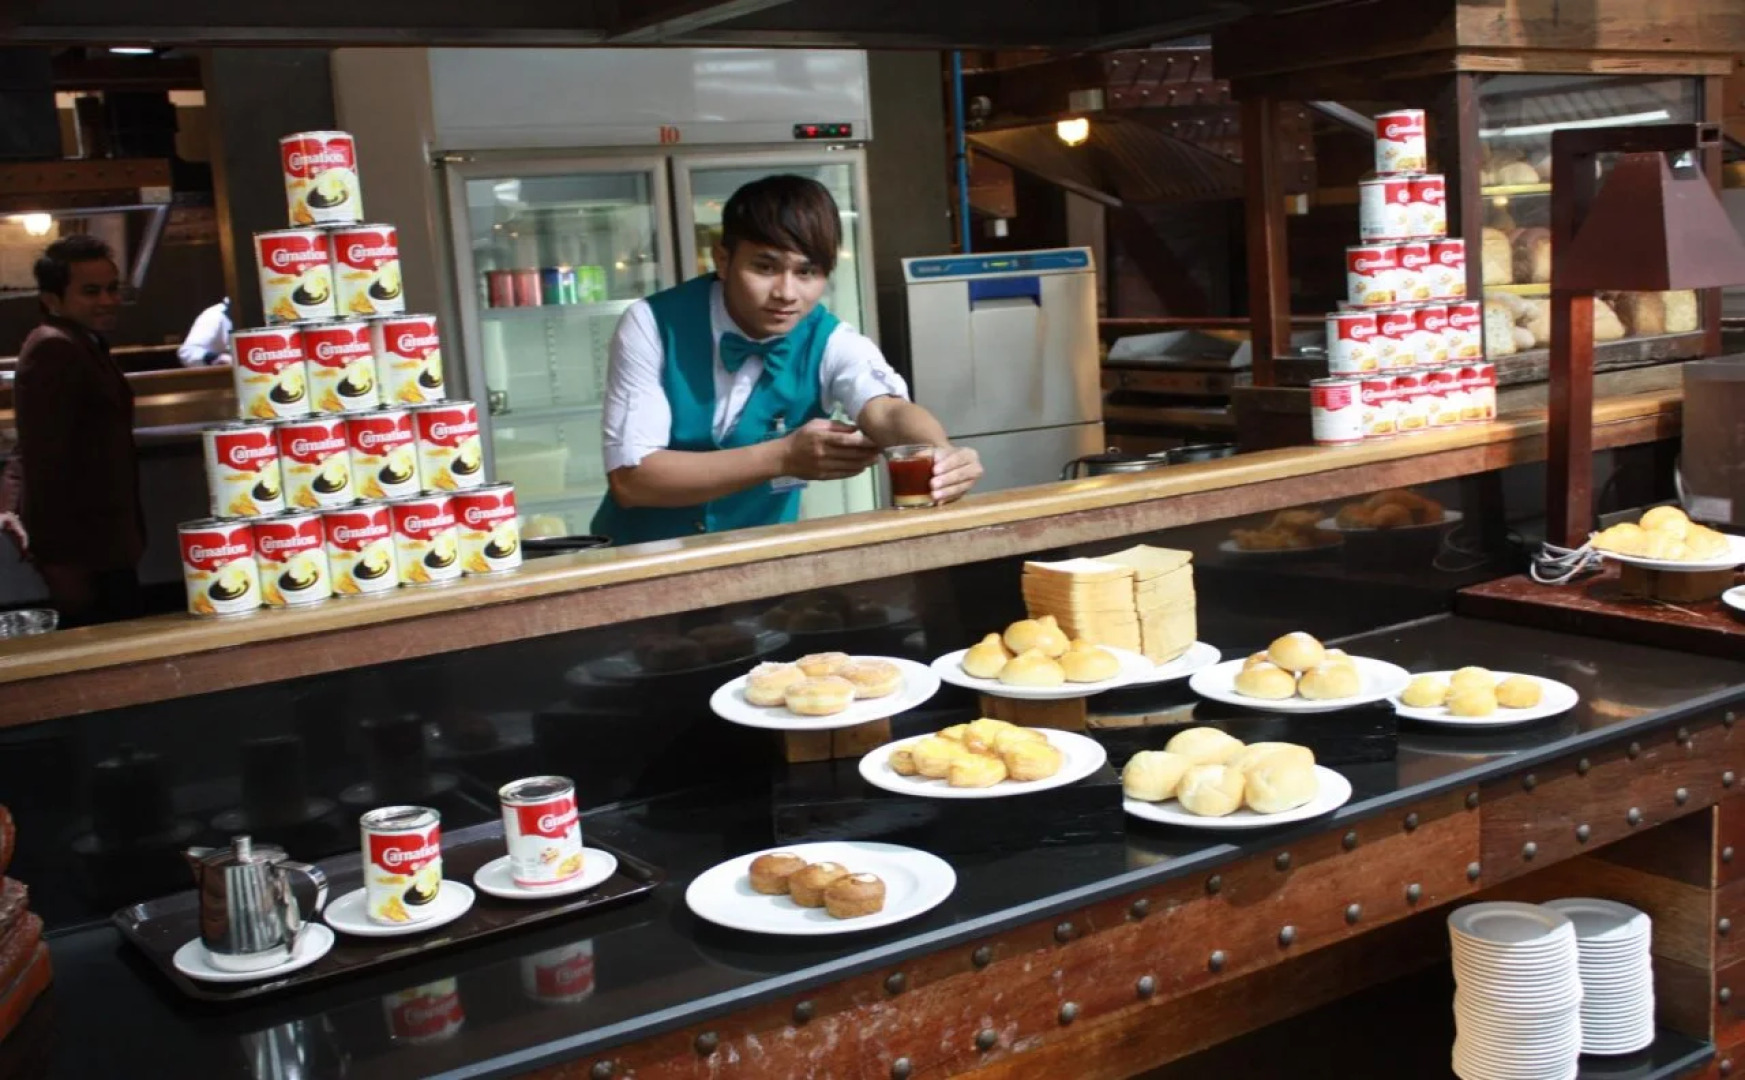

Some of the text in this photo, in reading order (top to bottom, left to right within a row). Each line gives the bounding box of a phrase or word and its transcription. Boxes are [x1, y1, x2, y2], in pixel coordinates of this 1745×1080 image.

[289, 152, 345, 170] Carnation
[272, 248, 328, 267] Carnation
[316, 341, 371, 360] Carnation
[291, 438, 346, 456] Carnation
[358, 430, 412, 448] Carnation
[333, 525, 388, 543] Carnation
[188, 544, 248, 562] Carnation
[259, 535, 317, 553] Carnation
